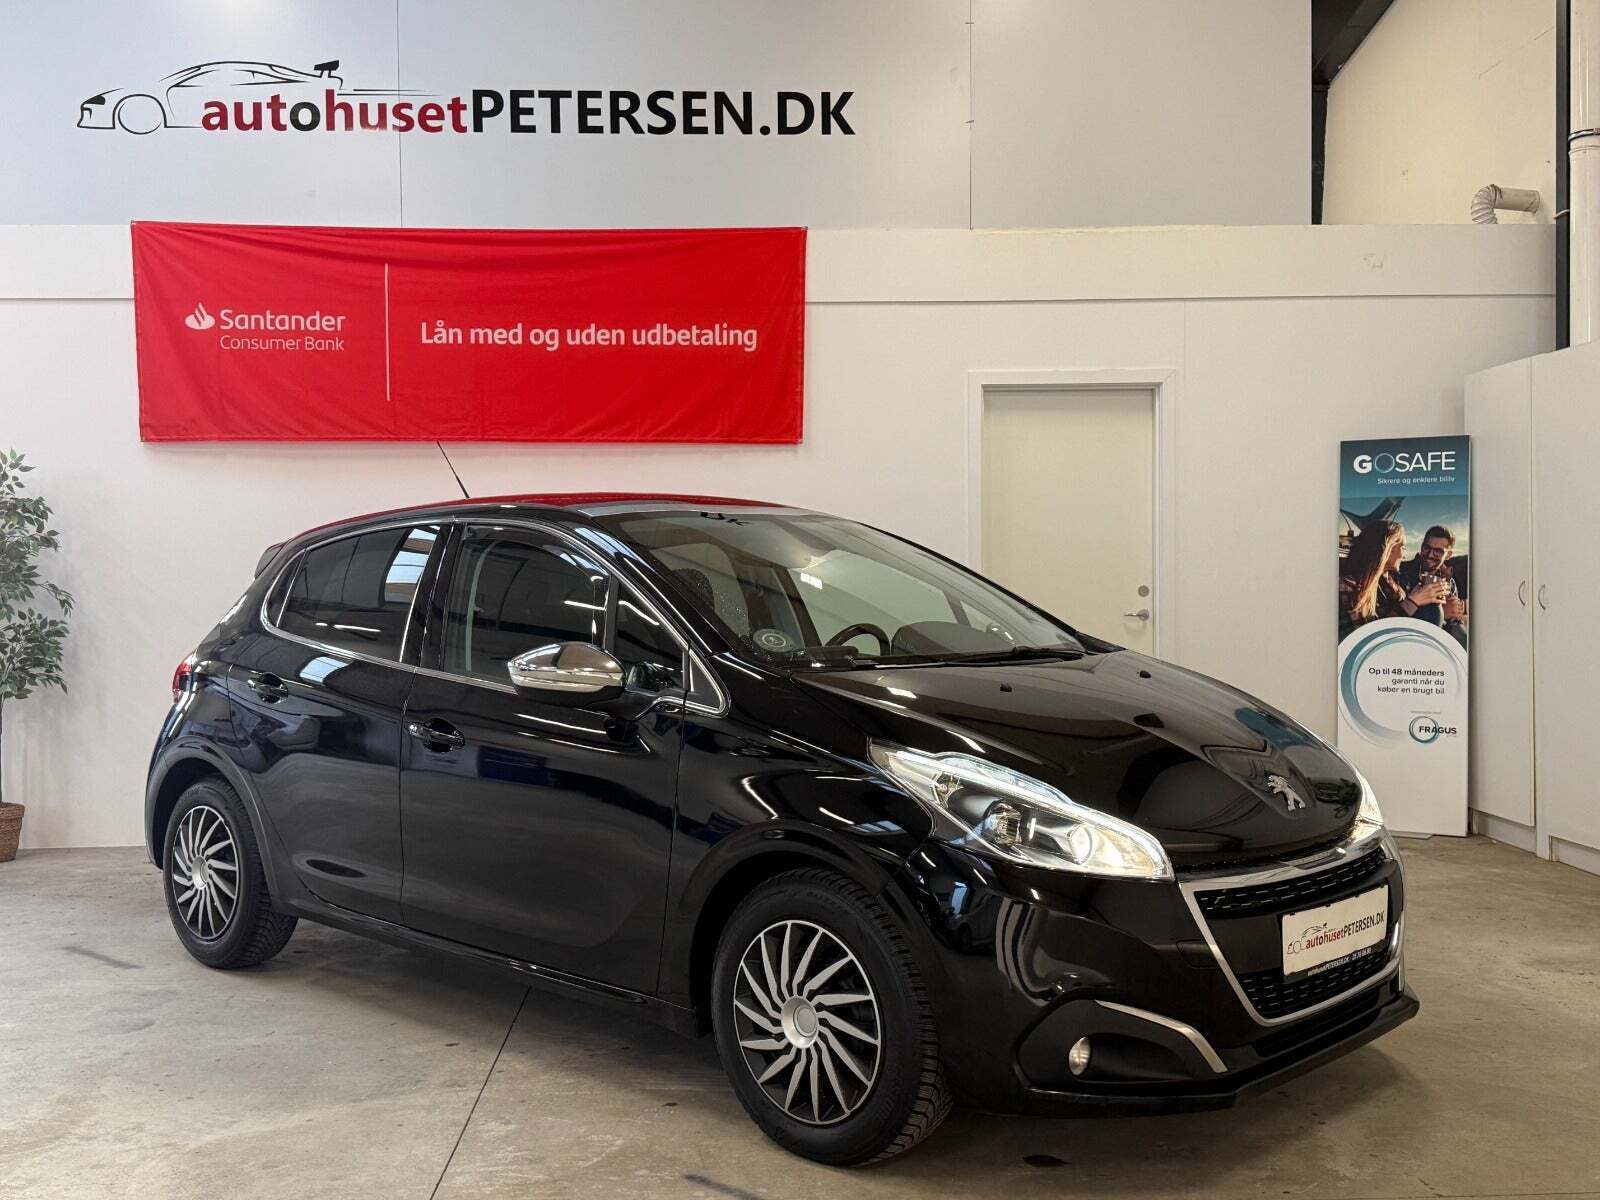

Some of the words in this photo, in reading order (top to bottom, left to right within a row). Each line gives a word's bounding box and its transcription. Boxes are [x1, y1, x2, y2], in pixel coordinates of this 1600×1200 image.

[201, 88, 855, 136] autohusetPETERSEN.DK
[220, 309, 346, 331] Santander
[220, 335, 301, 350] Consumer
[305, 336, 345, 351] Bank
[421, 320, 462, 344] Lån
[470, 323, 523, 345] med
[529, 327, 559, 351] og
[566, 324, 625, 345] uden
[632, 323, 757, 351] udbetaling
[1353, 451, 1456, 474] GOSAFE
[1369, 667, 1380, 675] Op
[1382, 667, 1390, 675] til
[1404, 668, 1444, 676] måneders
[1413, 687, 1433, 695] brugt
[1419, 726, 1457, 735] FRAGUS
[1306, 911, 1384, 949] autohusetPETERSEN.DK
